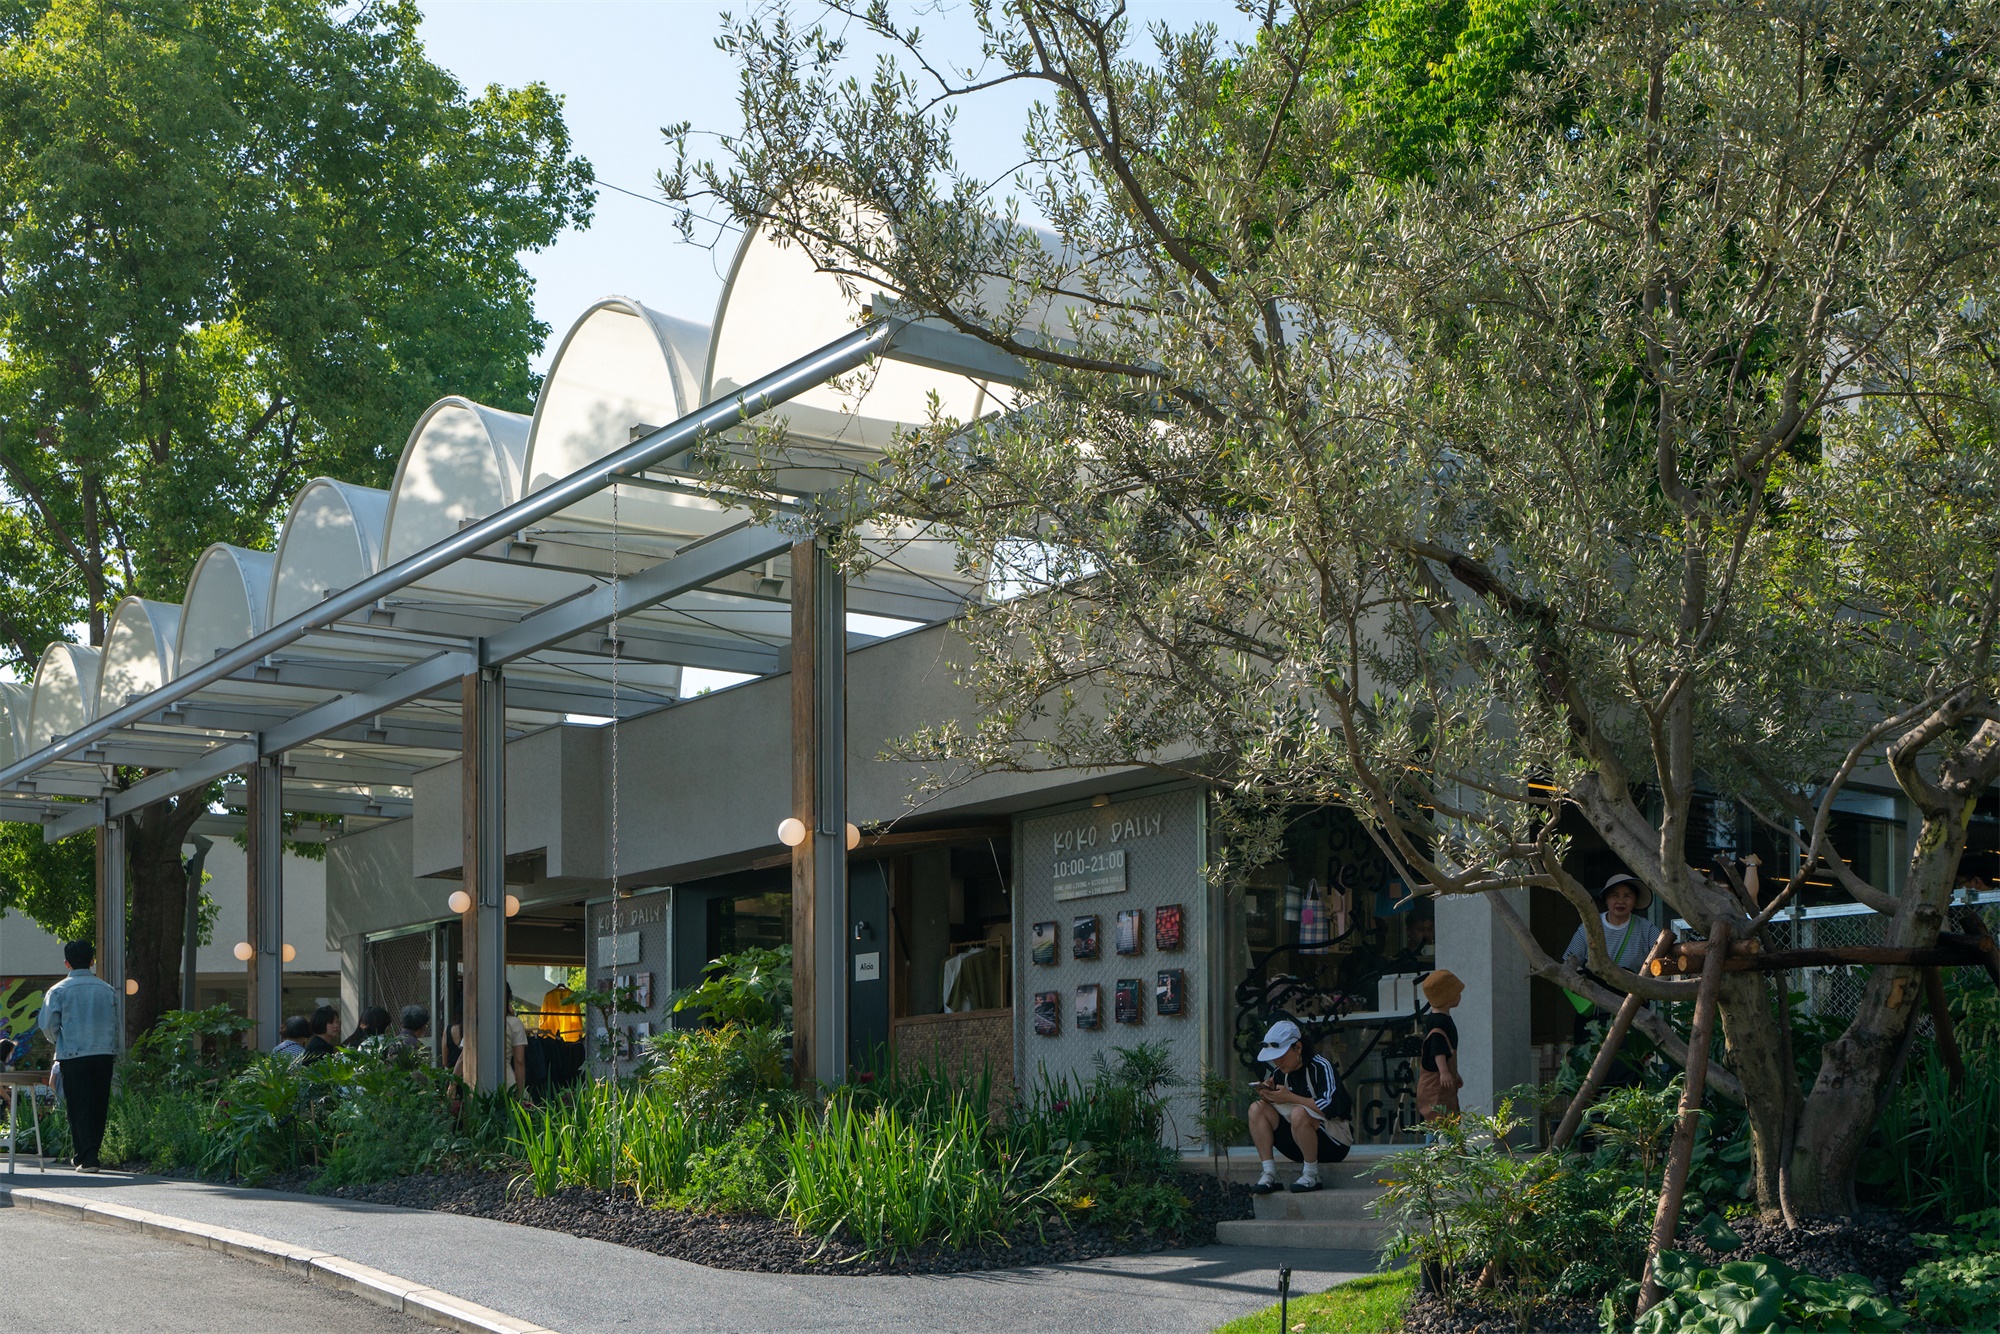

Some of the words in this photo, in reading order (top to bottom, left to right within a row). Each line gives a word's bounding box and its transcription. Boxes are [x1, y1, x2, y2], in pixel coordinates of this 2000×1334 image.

[1053, 826, 1097, 855] KOKO
[1110, 813, 1161, 843] DAILY
[1053, 851, 1124, 878] 10:00-21:00
[1073, 881, 1087, 889] LIVING
[1091, 877, 1109, 886] KITCHEN
[1109, 875, 1123, 883] TOOLS
[631, 906, 660, 925] DAILY
[1363, 1099, 1425, 1136] Grü
